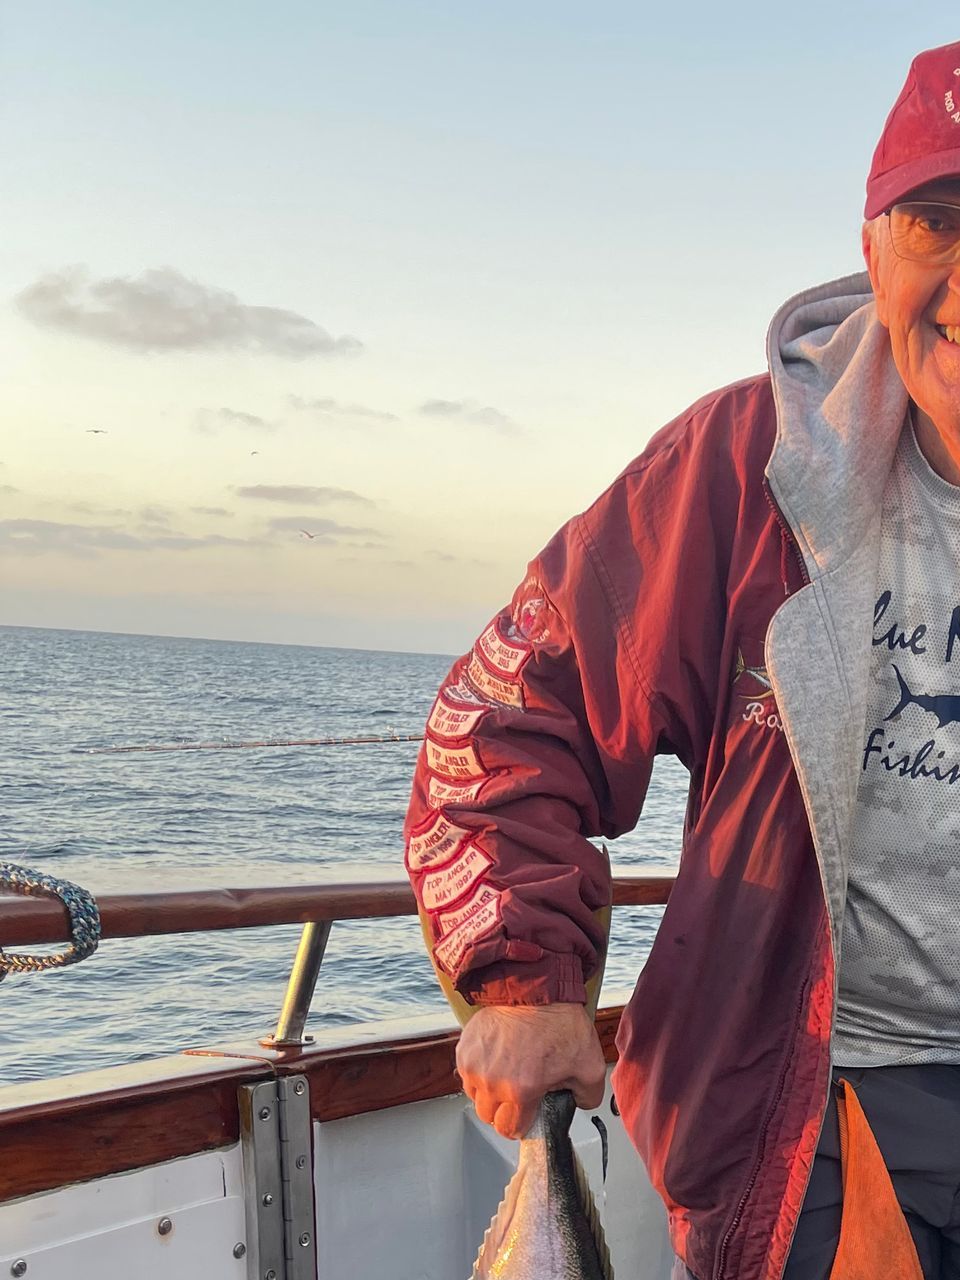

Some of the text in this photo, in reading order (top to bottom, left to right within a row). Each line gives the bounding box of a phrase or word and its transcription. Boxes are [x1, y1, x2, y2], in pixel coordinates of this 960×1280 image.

[944, 90, 955, 112] ROD
[872, 590, 927, 655] lue
[436, 706, 470, 722] TOP ANGLER
[411, 822, 450, 854] TOP ANGLER
[426, 851, 477, 890] TOP ANGLER
[435, 888, 452, 903] MAY
[442, 890, 494, 929] TOP ANGLER
